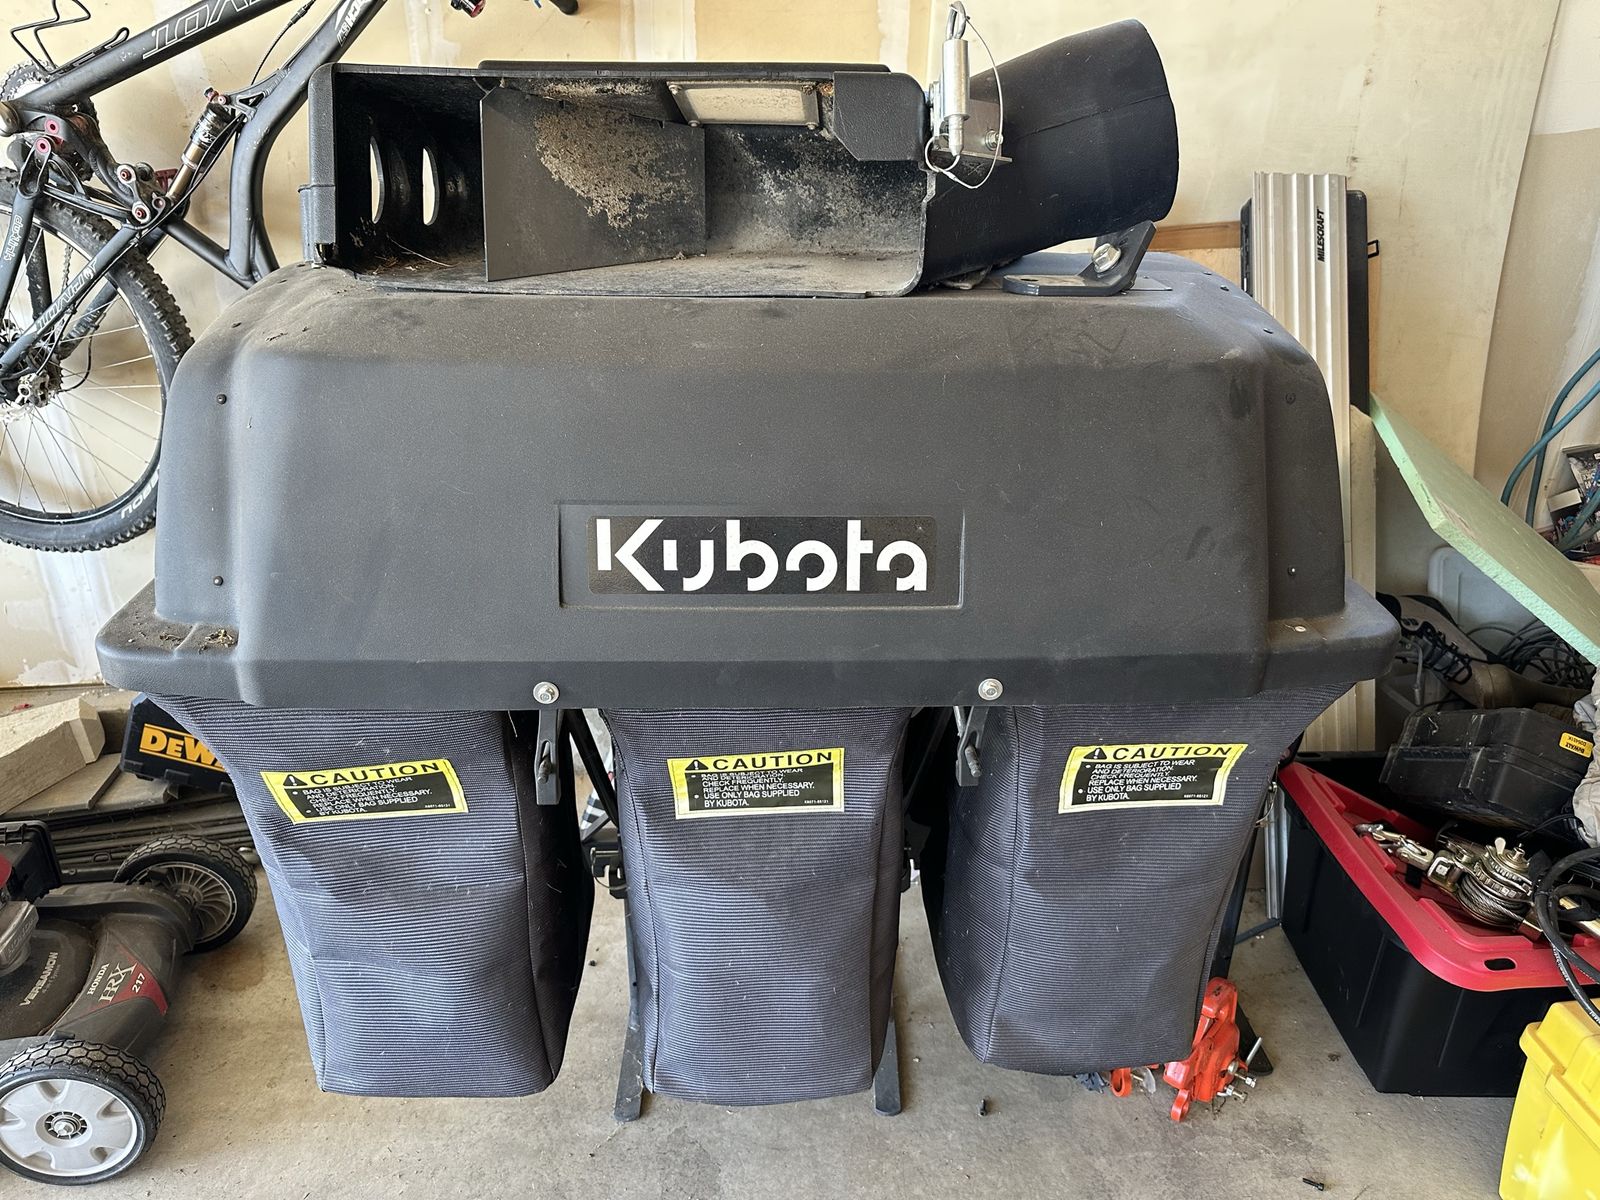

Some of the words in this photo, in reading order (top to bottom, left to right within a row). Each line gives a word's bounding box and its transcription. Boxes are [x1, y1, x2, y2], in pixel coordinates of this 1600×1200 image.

[1317, 208, 1326, 262] MILESCRAFT
[596, 518, 928, 592] Kubota
[1113, 747, 1232, 761] CAUTION
[713, 752, 832, 771] CAUTION
[1123, 761, 1160, 769] SUBJECT
[310, 763, 440, 785] CAUTION
[1111, 766, 1174, 775] DETERIORATION.
[1119, 771, 1170, 779] FREQUENTLY.
[703, 780, 730, 788] CHECK
[731, 777, 785, 785] FREQUENTLY.
[766, 782, 815, 790] NECESSARY.
[1088, 779, 1125, 787] REPLACE
[1150, 775, 1198, 783] NECESSARY.
[1144, 783, 1182, 791] SUPPLIED
[313, 798, 353, 808] REPLACE
[353, 794, 380, 803] WHEN
[380, 789, 433, 799] NECESSARY.
[762, 790, 800, 798] SUPPLIED
[1098, 793, 1130, 801] KUBOTA.
[379, 797, 419, 806] SUPPLIED
[704, 800, 715, 808] BY
[716, 799, 750, 807] KUBOTA.
[332, 807, 368, 815] KUBOTA.
[87, 963, 110, 996] HONDA
[99, 961, 138, 1003] HRX
[132, 973, 146, 994] 217
